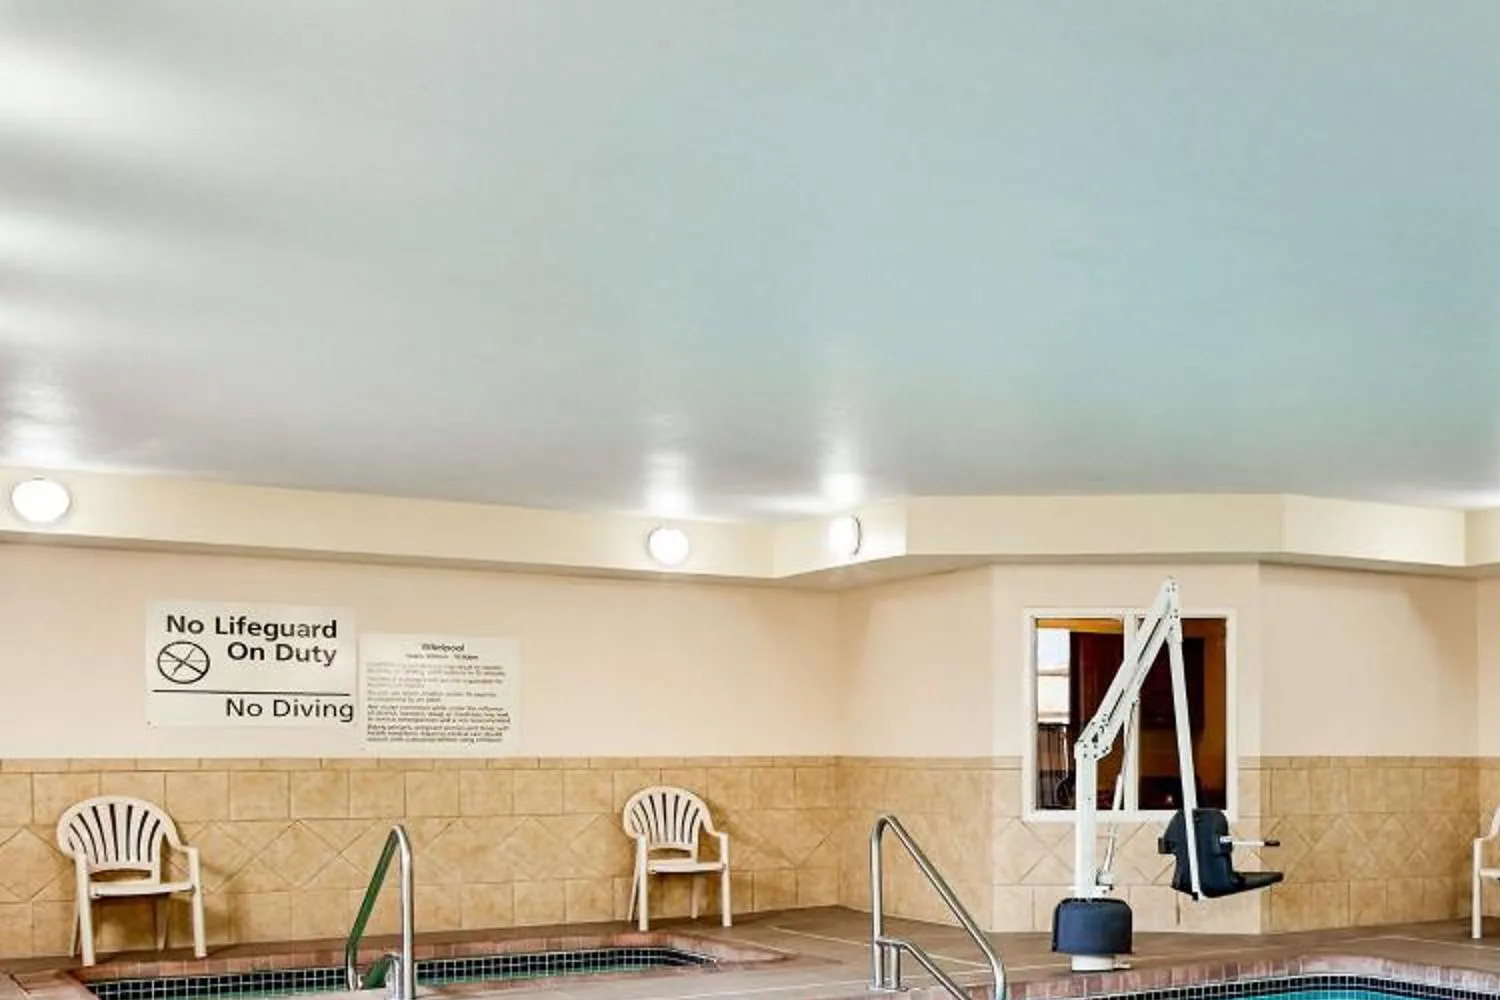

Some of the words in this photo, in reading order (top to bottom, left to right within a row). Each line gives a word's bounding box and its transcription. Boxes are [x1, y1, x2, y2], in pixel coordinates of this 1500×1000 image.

[166, 615, 205, 635] No
[215, 616, 337, 642] Lifeguard
[227, 642, 265, 661] On
[275, 643, 337, 667] Duty
[226, 698, 263, 717] No
[273, 699, 354, 723] Diving
